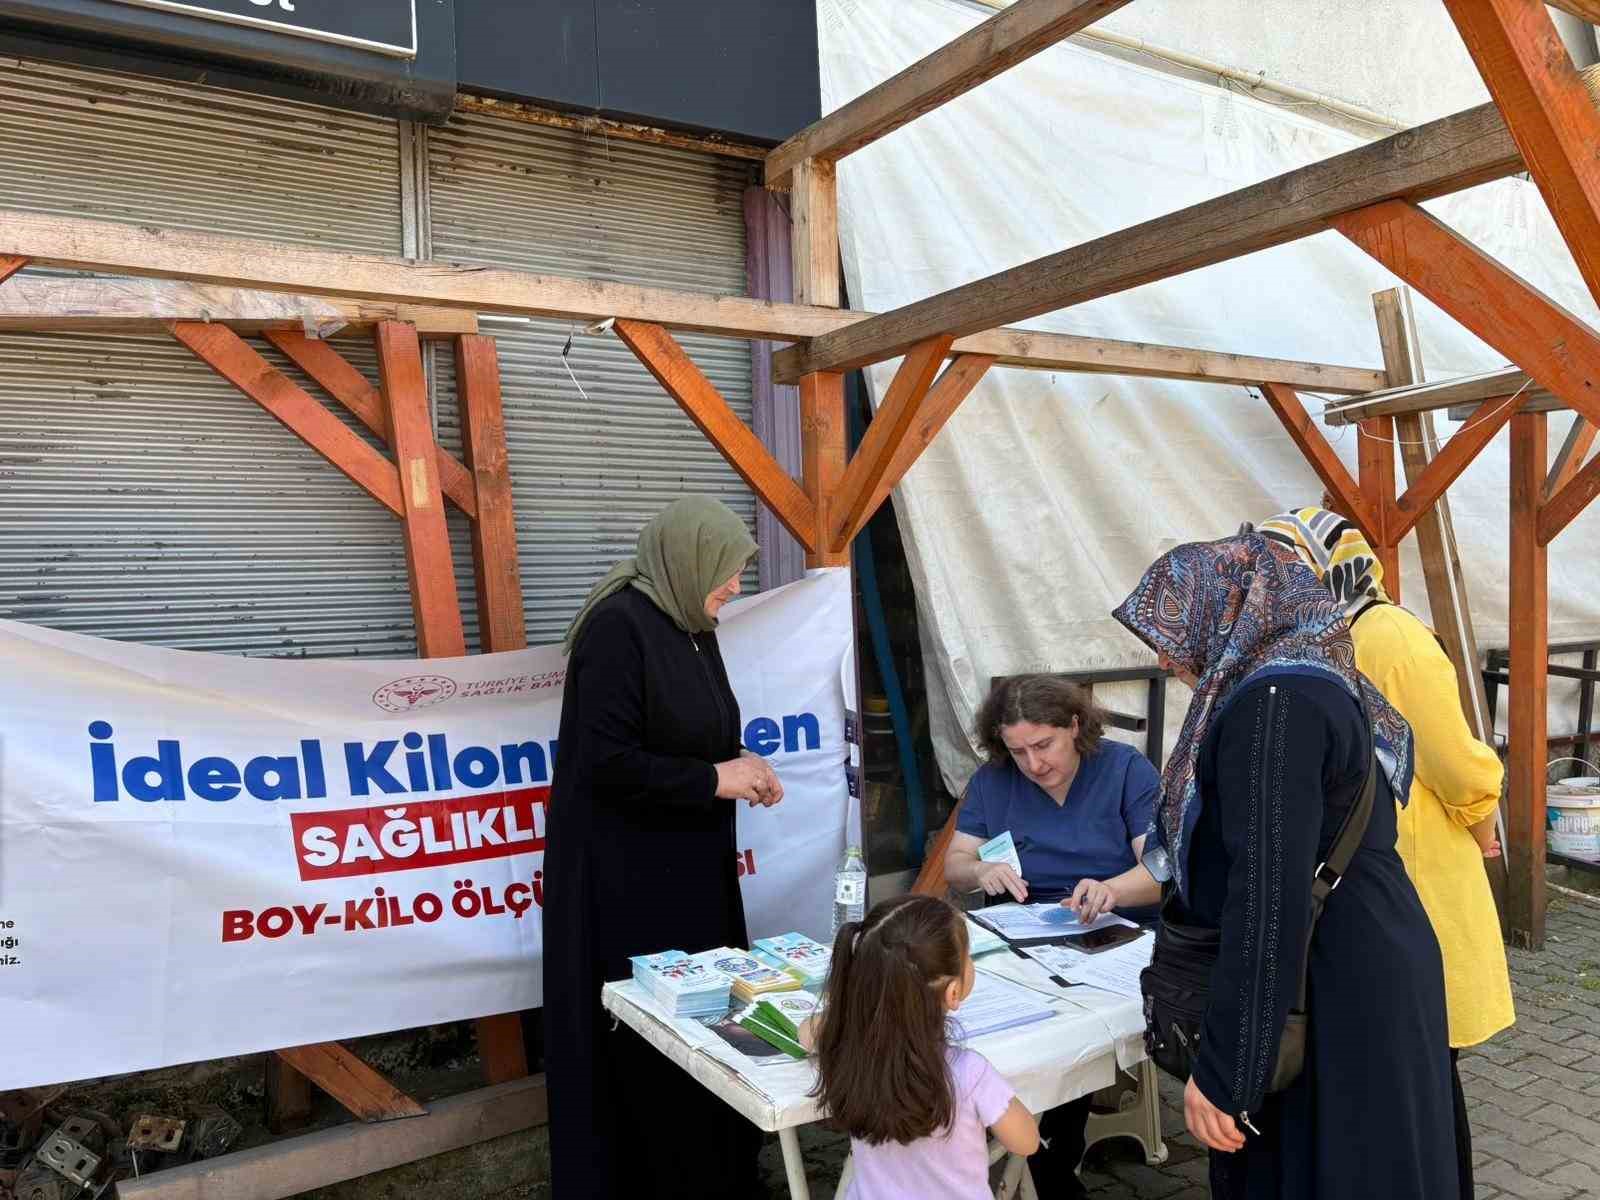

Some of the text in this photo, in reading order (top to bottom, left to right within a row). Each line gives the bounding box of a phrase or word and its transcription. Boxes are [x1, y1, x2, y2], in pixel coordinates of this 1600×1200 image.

[88, 720, 327, 802] İdeal
[301, 801, 546, 867] SAĞLIKLI
[221, 886, 443, 943] BOY-KİLO
